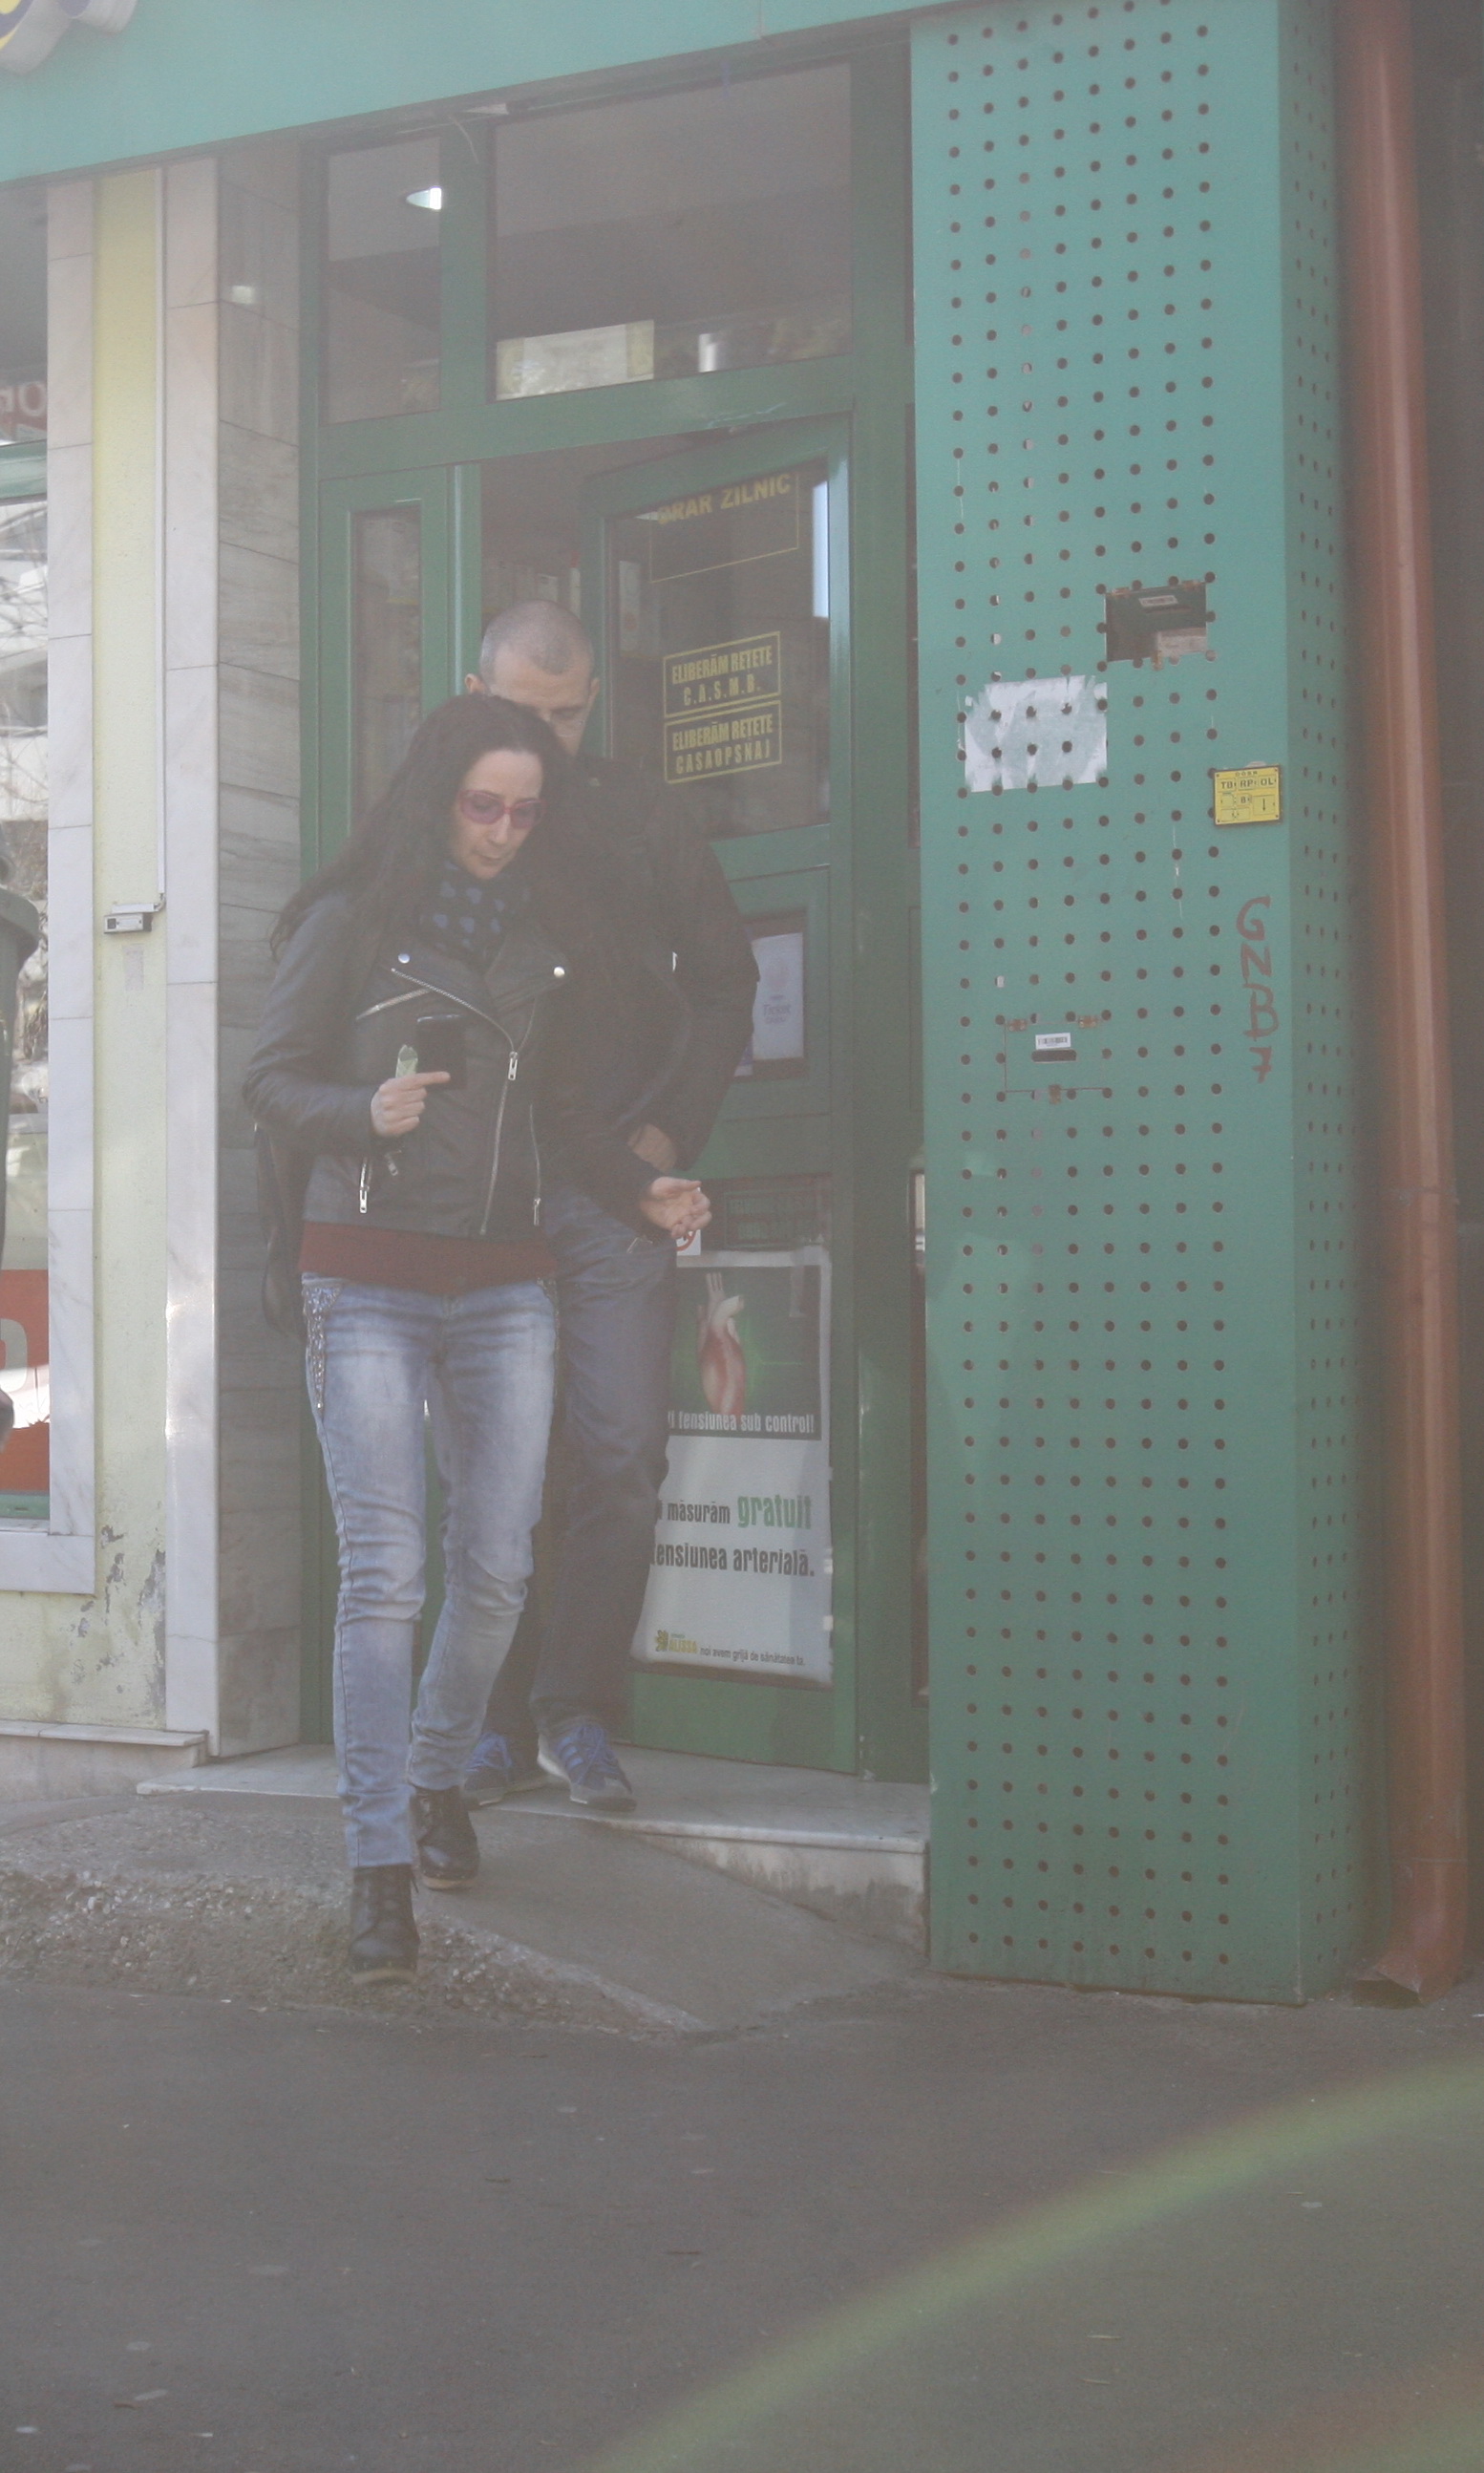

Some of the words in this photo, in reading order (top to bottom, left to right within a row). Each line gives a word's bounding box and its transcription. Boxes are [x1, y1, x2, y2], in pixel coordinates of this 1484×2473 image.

[720, 473, 793, 509] ZILNIC
[675, 738, 771, 775] CASAOPSNAJ
[678, 1411, 737, 1432] tensiunea
[740, 1412, 762, 1433] sub
[765, 1414, 815, 1435] control!
[667, 1500, 731, 1524] măsurăm
[737, 1494, 812, 1530] gratuit
[732, 1546, 815, 1577] arterială.
